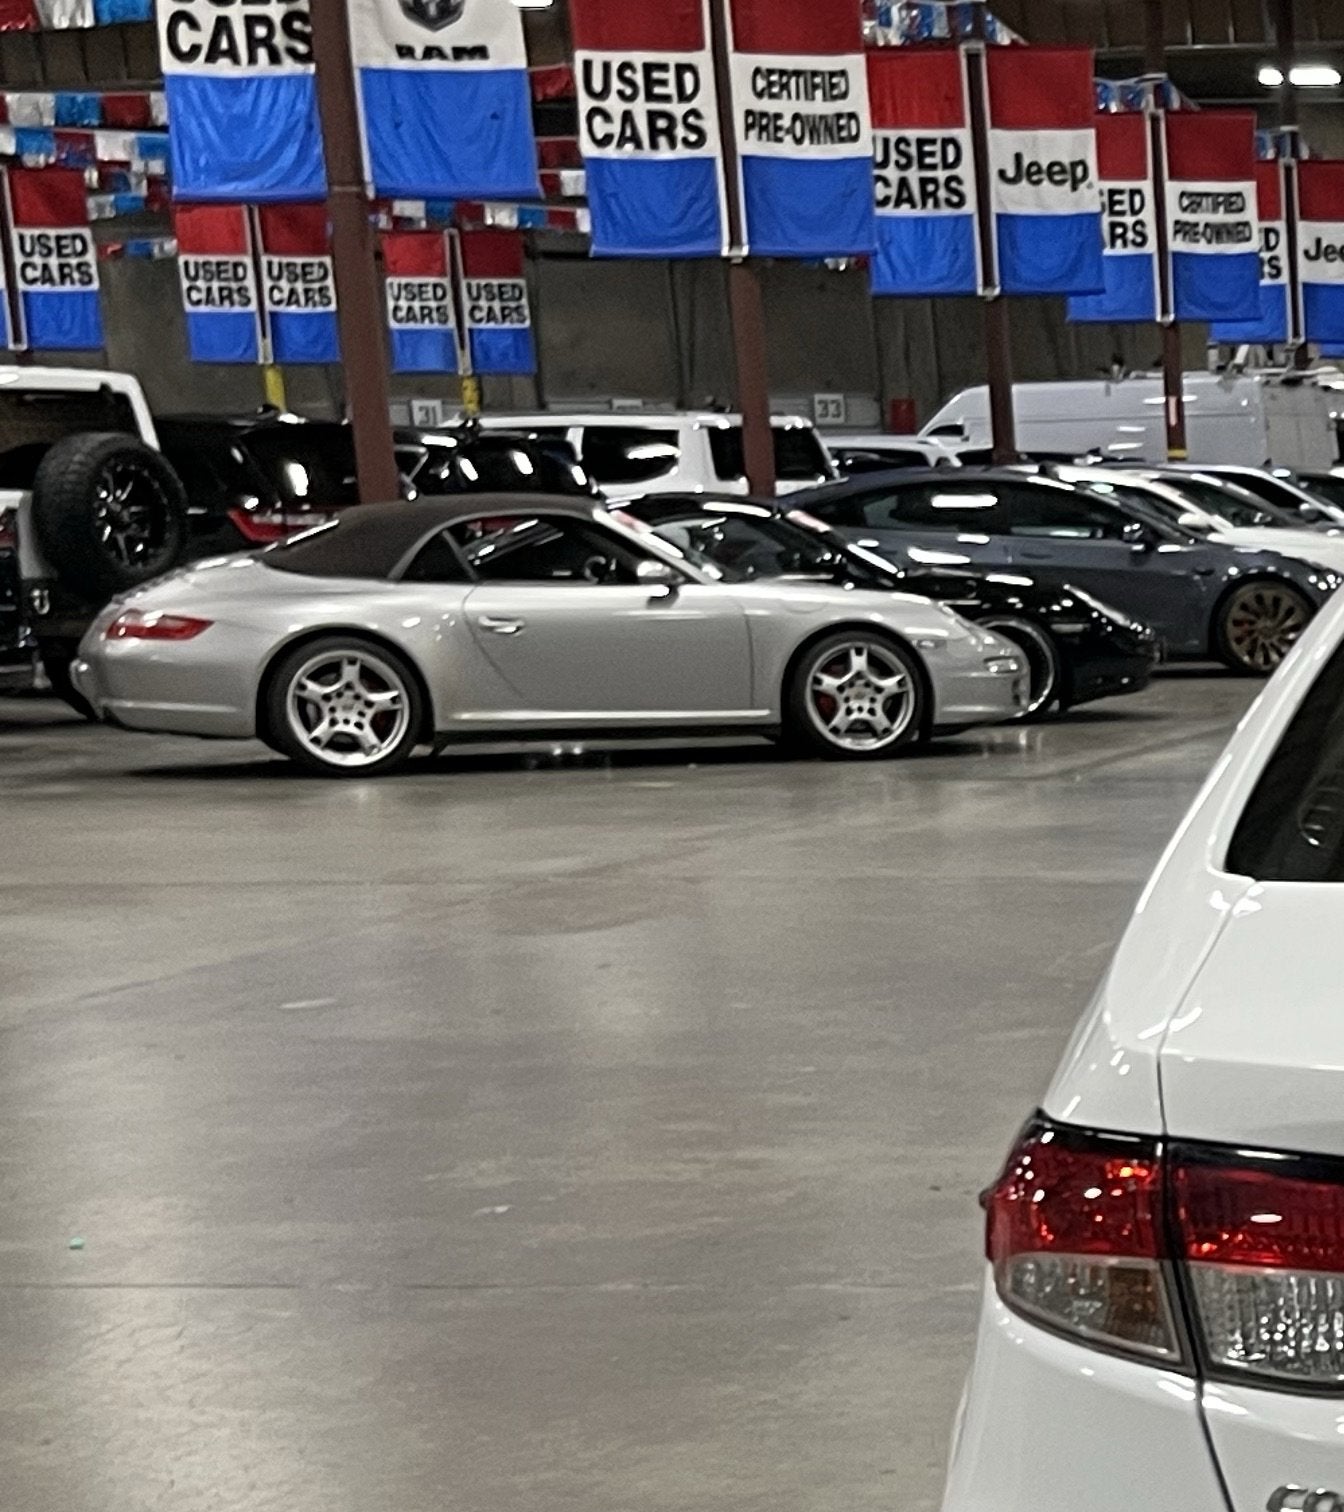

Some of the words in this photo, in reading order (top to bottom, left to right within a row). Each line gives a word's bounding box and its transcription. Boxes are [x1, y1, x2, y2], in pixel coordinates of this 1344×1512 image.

[167, 10, 315, 65] CARS
[395, 44, 489, 60] RAM
[582, 58, 700, 104] USED
[751, 66, 849, 102] CERTIFIED
[585, 106, 707, 150] CARS
[744, 109, 860, 146] PRE-OWNED
[873, 136, 963, 171] USED
[998, 152, 1089, 192] Jeep
[874, 175, 966, 209] CARS
[18, 233, 88, 258] USED
[20, 261, 93, 286] CARS
[183, 260, 247, 282] USED
[266, 260, 329, 283] USED
[186, 285, 251, 307] CARS
[268, 285, 332, 307] CARS
[389, 282, 447, 301] USED
[466, 282, 524, 301] USED
[392, 305, 449, 324] CARS
[468, 305, 527, 324] CARS
